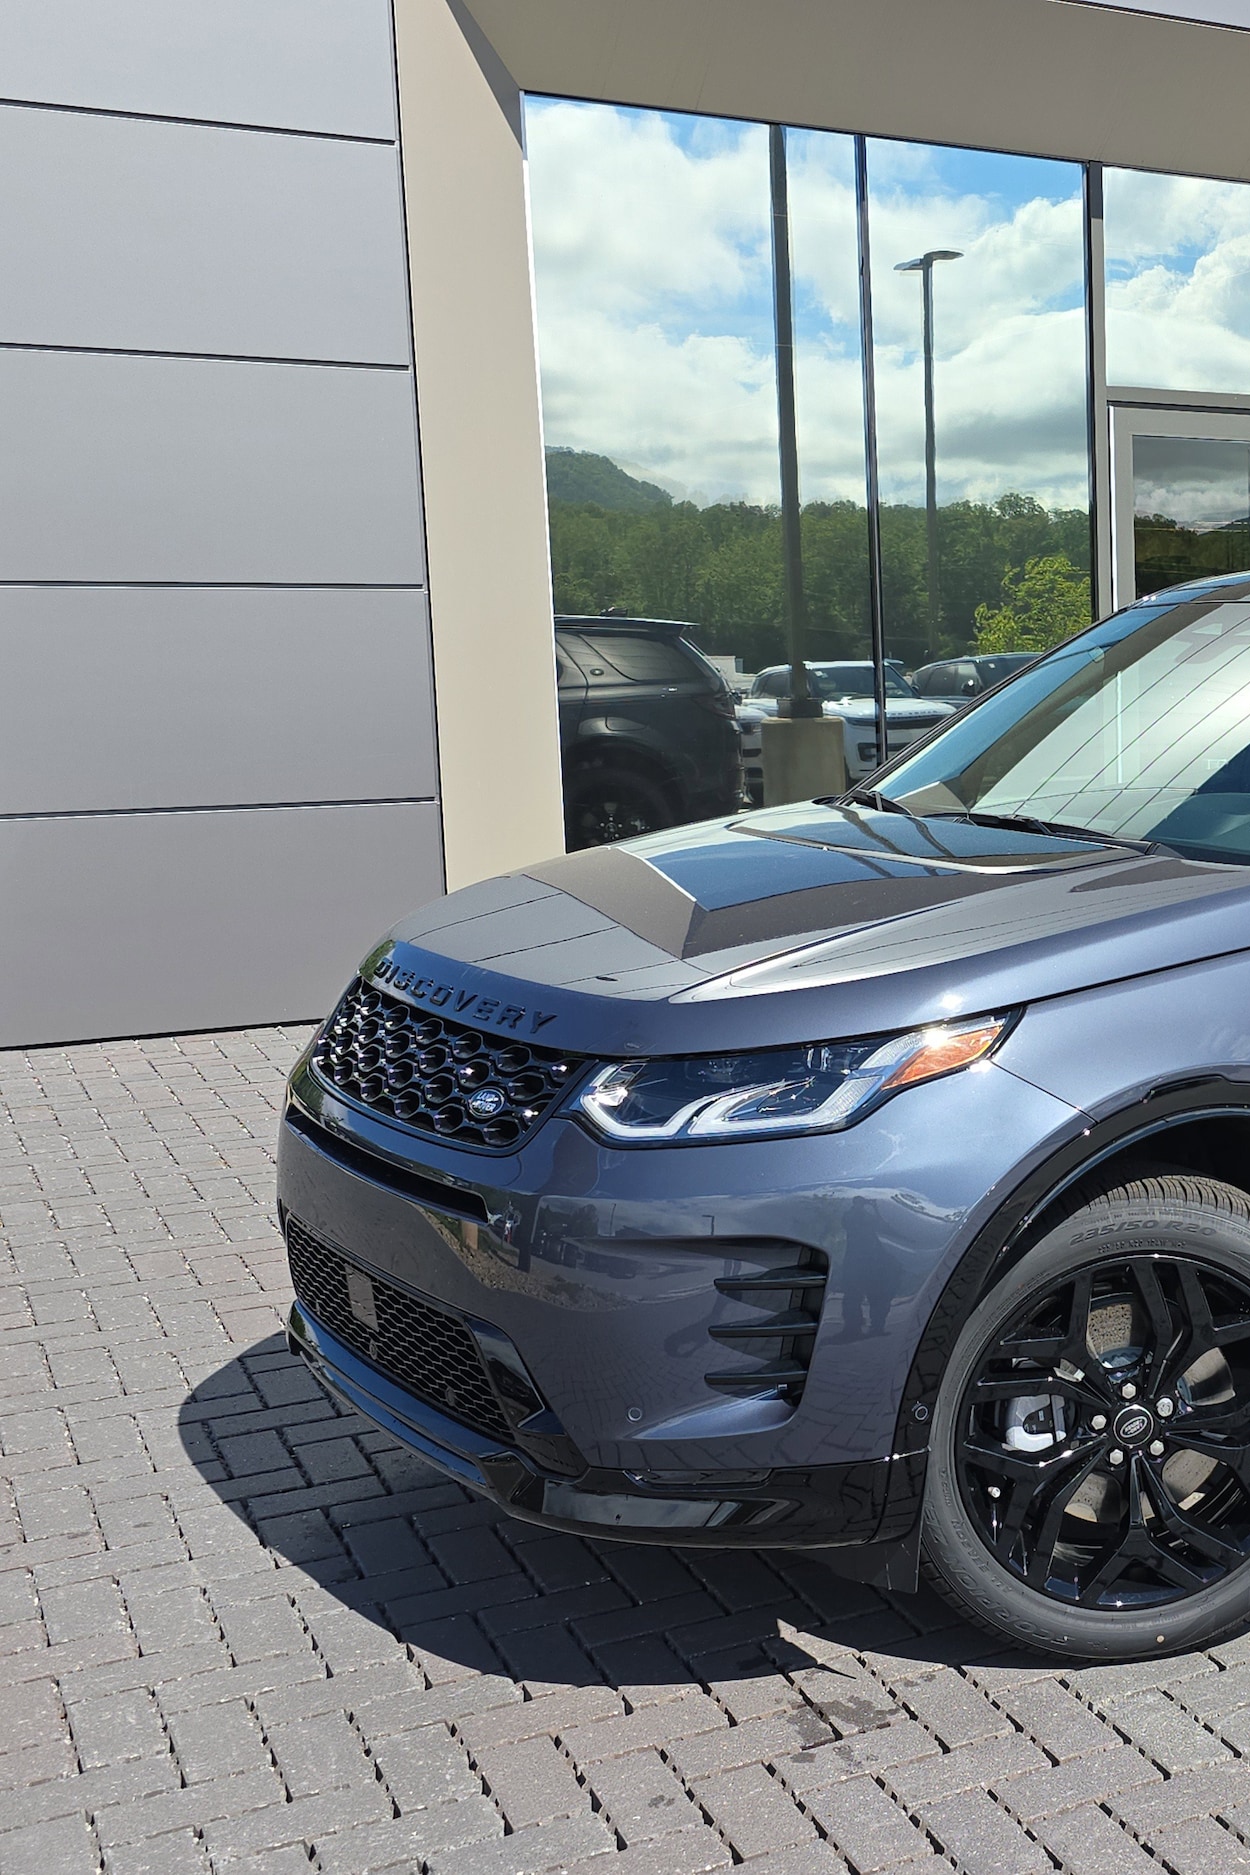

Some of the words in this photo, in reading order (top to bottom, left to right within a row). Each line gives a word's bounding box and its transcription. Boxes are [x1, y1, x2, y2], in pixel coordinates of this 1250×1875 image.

[373, 957, 558, 1034] DISCOVERY
[1070, 1219, 1160, 1246] 235/50
[1165, 1220, 1217, 1236] R20
